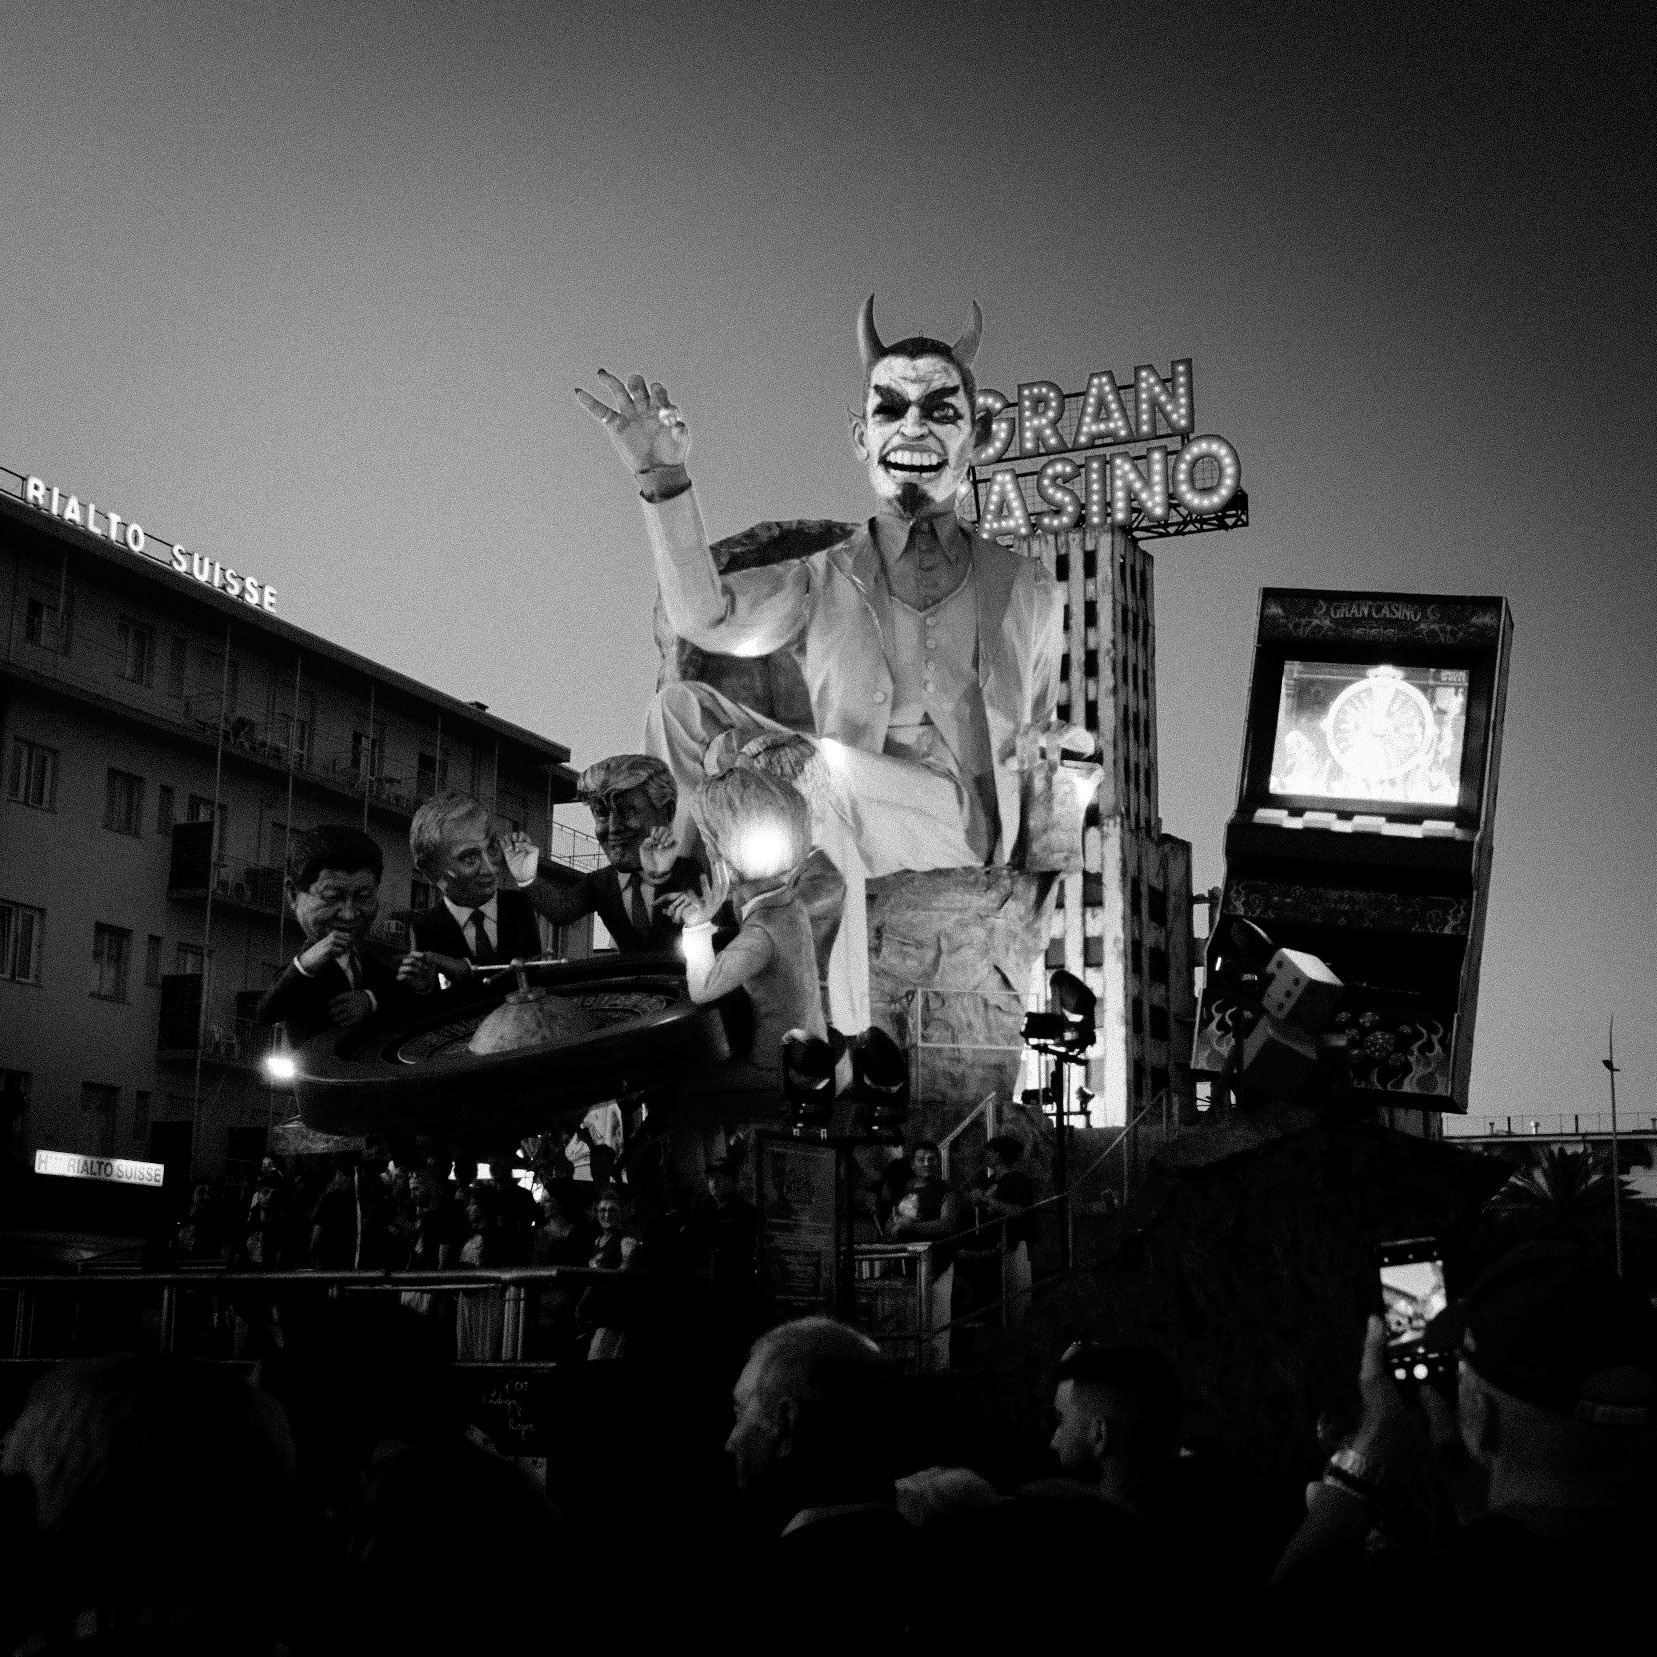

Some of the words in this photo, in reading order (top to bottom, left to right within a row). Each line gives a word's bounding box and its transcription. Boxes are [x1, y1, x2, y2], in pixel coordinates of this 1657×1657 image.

[970, 358, 1195, 467] GRAN
[956, 433, 1242, 540] ASINO
[26, 474, 145, 552] RIALTO
[171, 544, 277, 613] SUISSE
[1330, 601, 1371, 619] GRAN
[1372, 602, 1422, 622] CASINO
[67, 1157, 113, 1178] RIALTO
[116, 1163, 162, 1184] SUISSE
